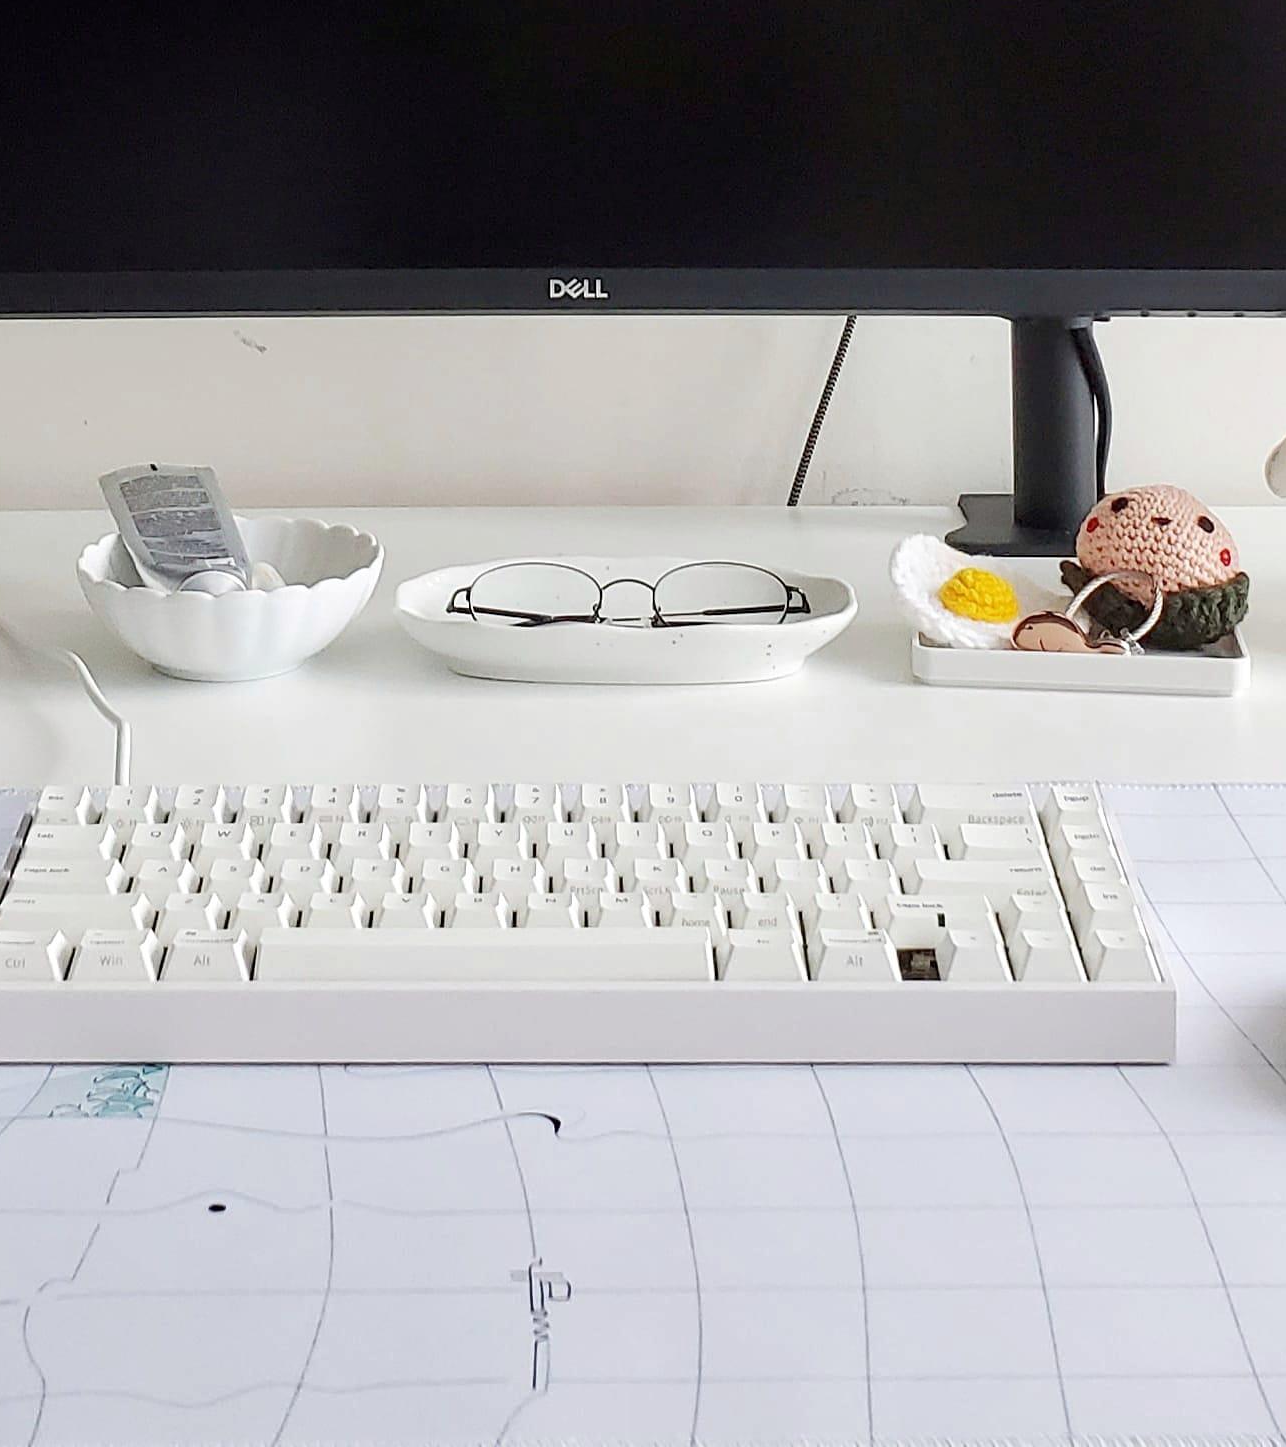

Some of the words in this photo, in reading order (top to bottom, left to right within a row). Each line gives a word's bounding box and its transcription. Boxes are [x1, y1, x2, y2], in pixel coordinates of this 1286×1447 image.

[550, 278, 608, 298] DELL
[968, 814, 1025, 825] Backspace
[5, 957, 26, 968] Ctrl
[100, 955, 123, 967] Win
[193, 954, 211, 966] Alt
[846, 954, 863, 967] Alt
